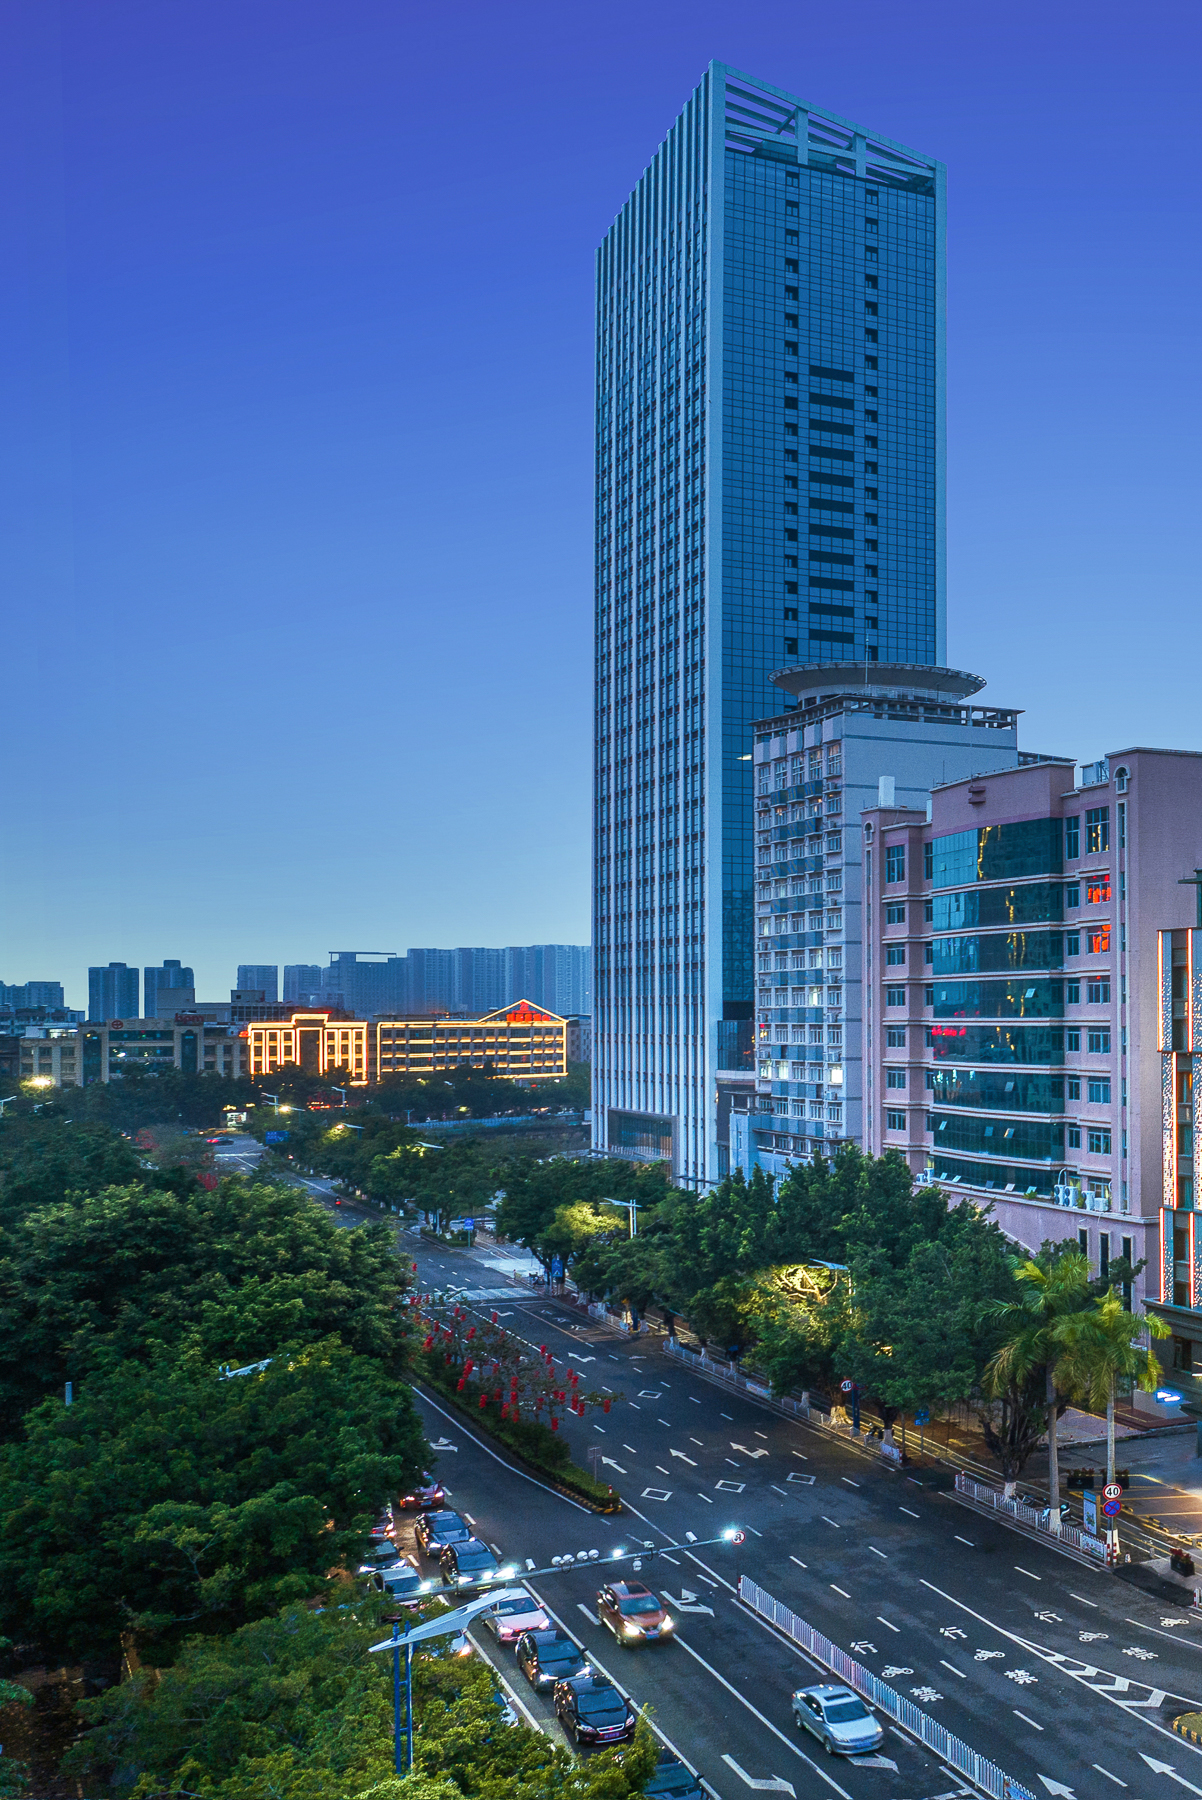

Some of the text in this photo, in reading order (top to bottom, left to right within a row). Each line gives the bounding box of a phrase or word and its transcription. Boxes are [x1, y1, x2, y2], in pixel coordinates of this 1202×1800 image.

[1106, 1487, 1119, 1496] 40
[1034, 1610, 1063, 1623] 行
[939, 1626, 968, 1640] 行
[850, 1640, 879, 1654] 行
